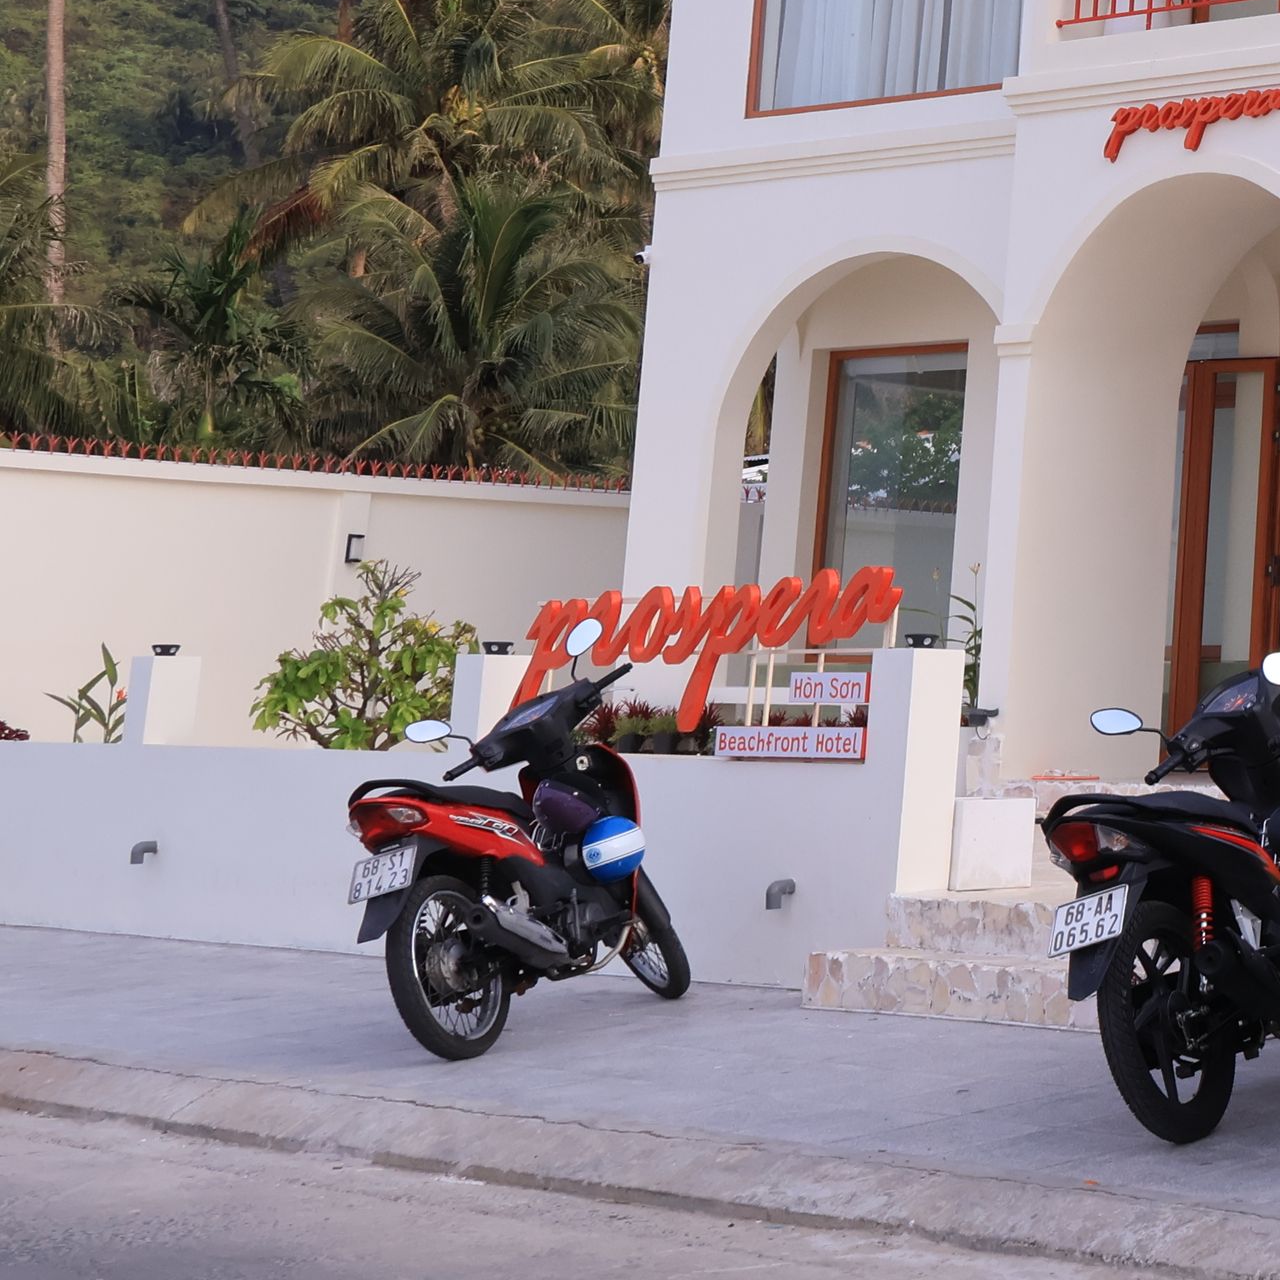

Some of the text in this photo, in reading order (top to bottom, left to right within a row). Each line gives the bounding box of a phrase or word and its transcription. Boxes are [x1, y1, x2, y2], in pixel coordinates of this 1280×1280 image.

[793, 677, 862, 699] Hòn Sơn
[718, 731, 858, 754] Beachfront Hotel
[362, 851, 405, 879] 68-S1
[353, 868, 409, 900] 814.23
[1064, 892, 1114, 927] 68-AA
[1053, 913, 1119, 952] 065.62
